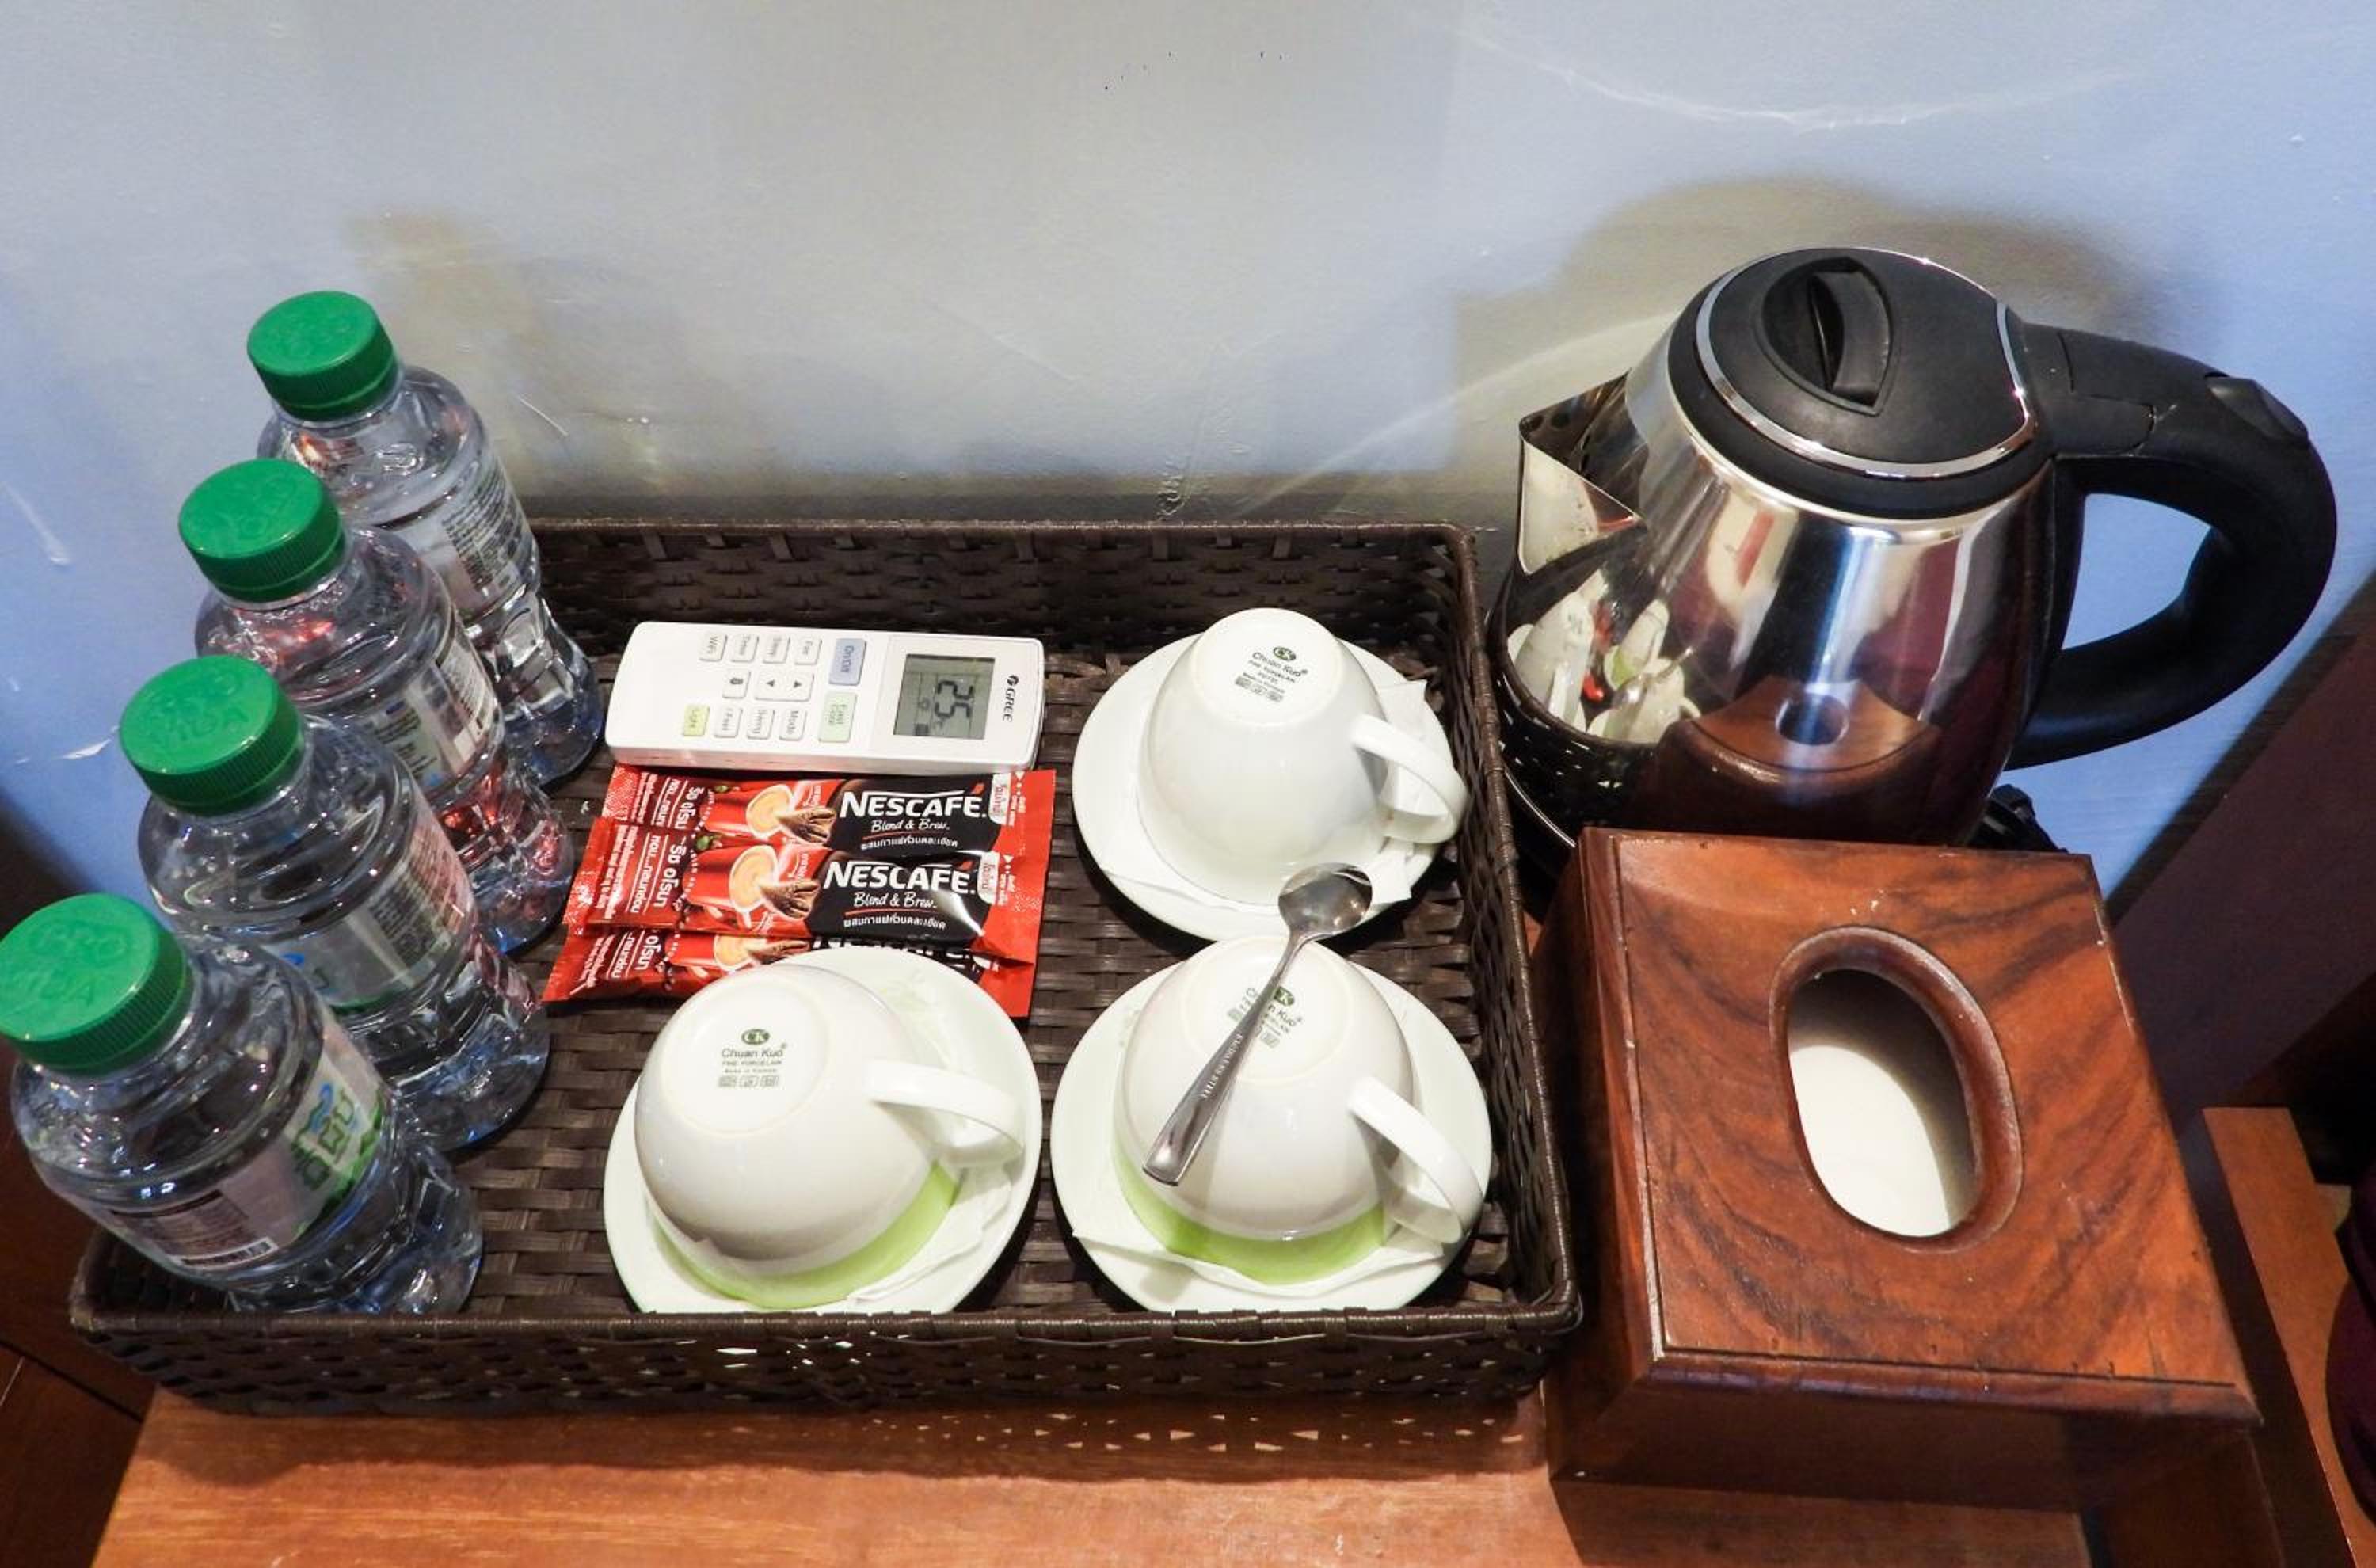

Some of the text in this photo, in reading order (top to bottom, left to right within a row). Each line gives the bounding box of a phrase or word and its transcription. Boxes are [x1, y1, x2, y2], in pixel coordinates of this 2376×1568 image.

[934, 679, 974, 719] 25
[1003, 687, 1016, 722] GREE
[872, 820, 904, 832] Blend
[905, 820, 915, 829] &
[854, 892, 888, 908] Blend
[890, 894, 901, 907] &
[722, 1048, 758, 1058] Chuan
